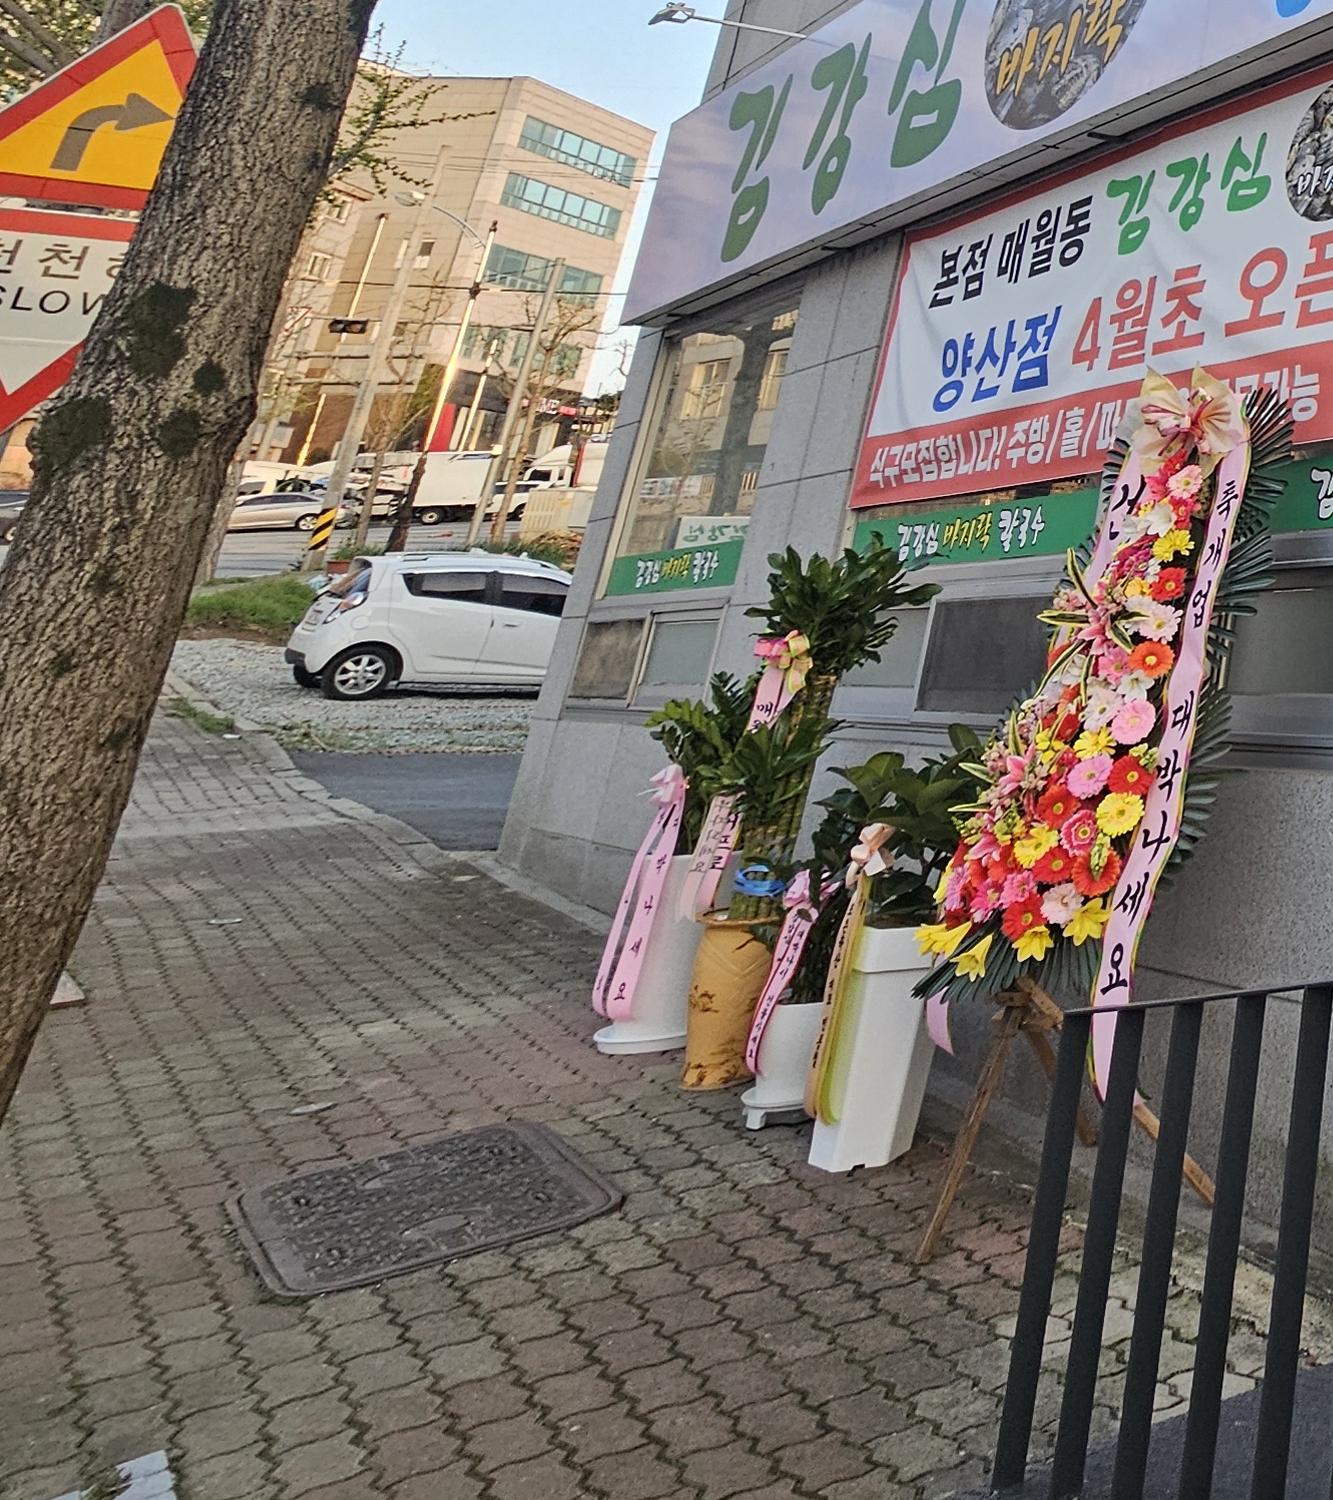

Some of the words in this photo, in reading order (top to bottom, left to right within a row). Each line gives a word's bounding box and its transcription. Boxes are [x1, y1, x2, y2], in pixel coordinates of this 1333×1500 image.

[930, 237, 984, 308] 본점
[996, 195, 1092, 280] 매월동
[1107, 131, 1271, 256] 김강심
[931, 305, 1062, 413] 양산점
[1071, 266, 1207, 374] 4월초
[692, 549, 720, 584] 칼국수
[897, 521, 941, 562] 김강심
[943, 511, 992, 552] 바지락
[998, 505, 1046, 552] 칼국수
[1099, 689, 1195, 997] 대박나세요
